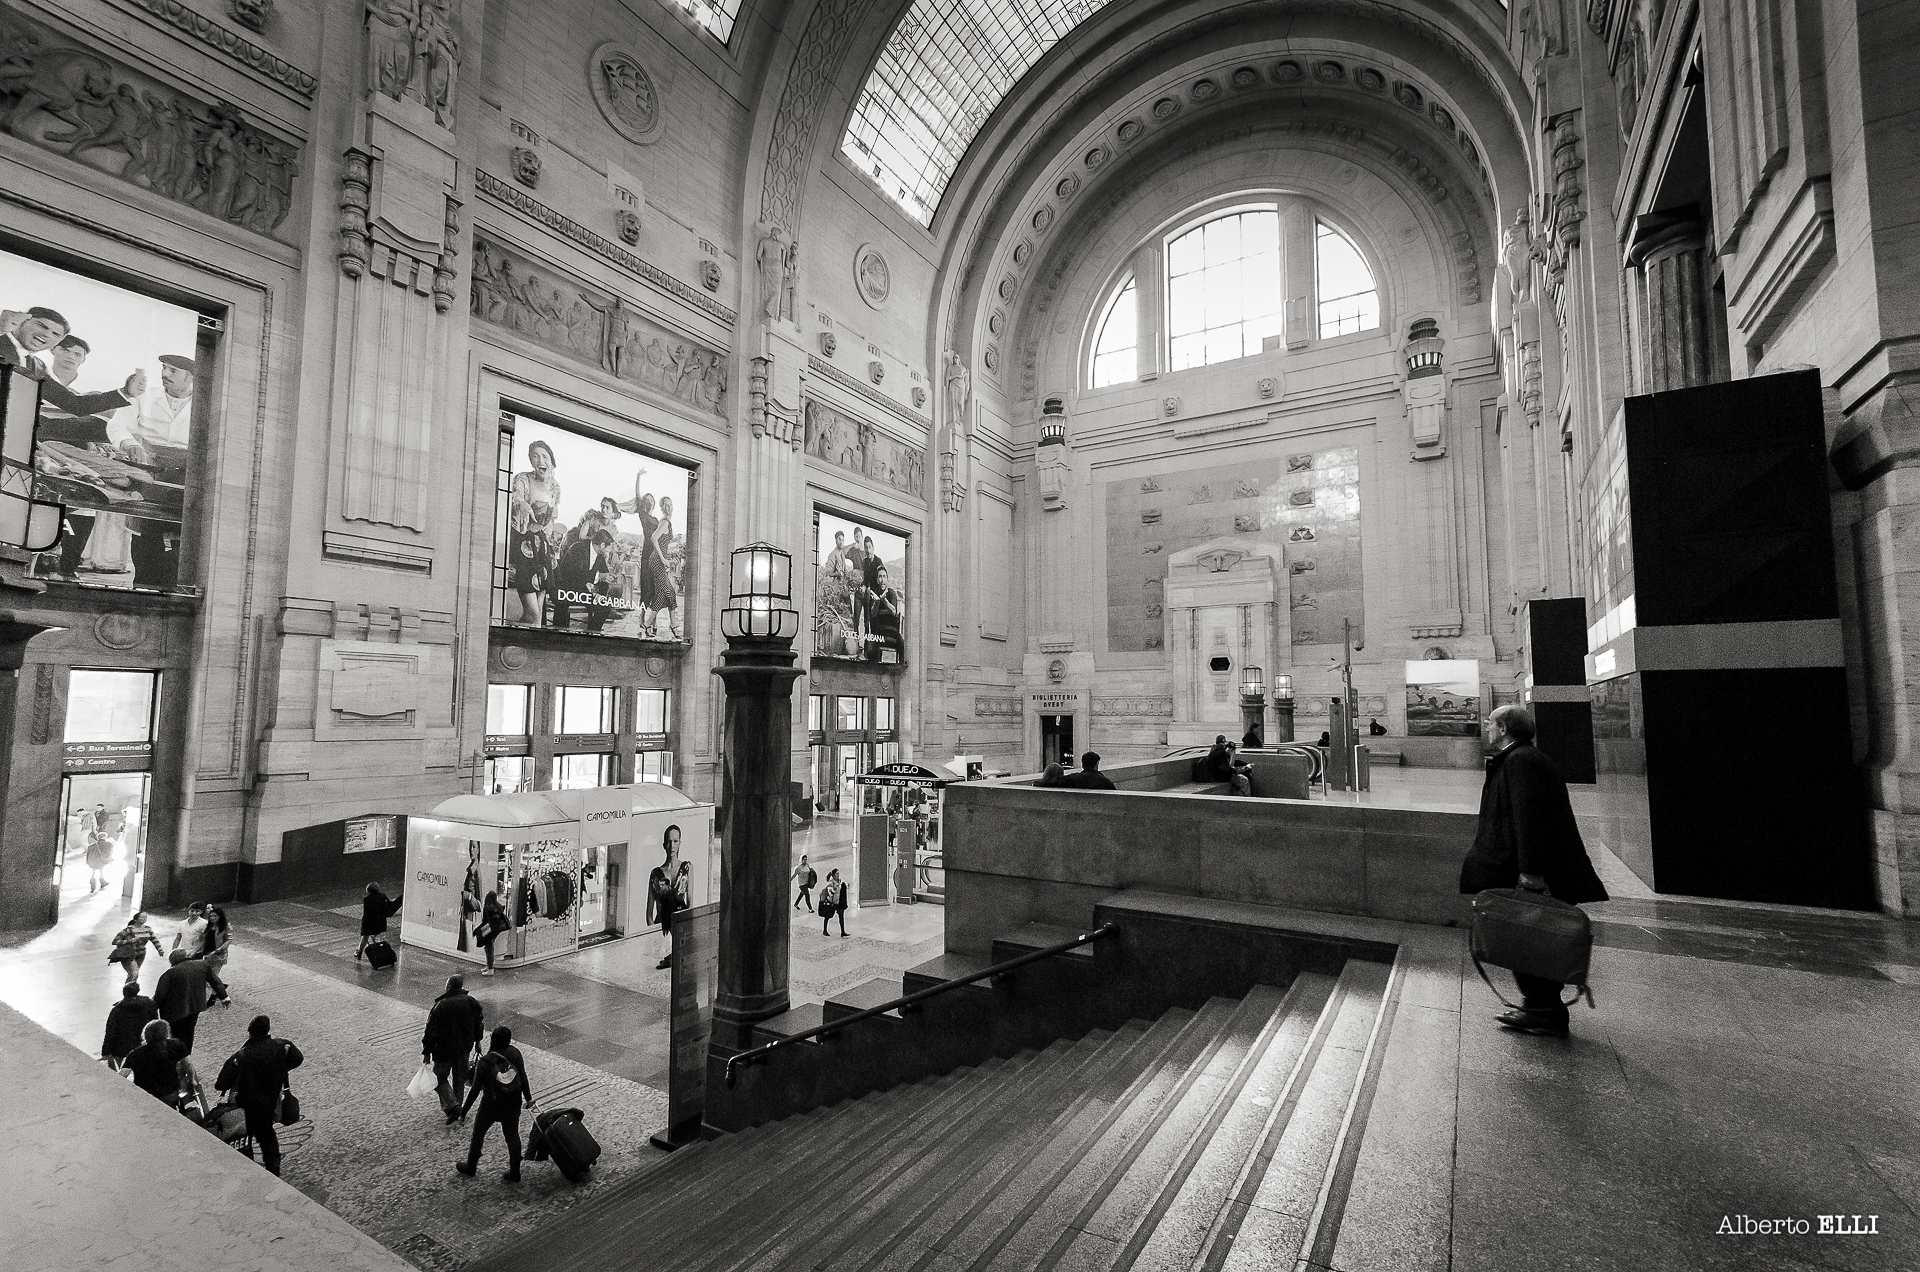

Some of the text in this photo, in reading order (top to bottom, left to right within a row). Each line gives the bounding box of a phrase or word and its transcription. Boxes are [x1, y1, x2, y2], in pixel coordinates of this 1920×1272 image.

[106, 744, 143, 752] Terminal
[586, 810, 627, 822] CAMOMILLA
[416, 870, 449, 887] CAMOMILLA
